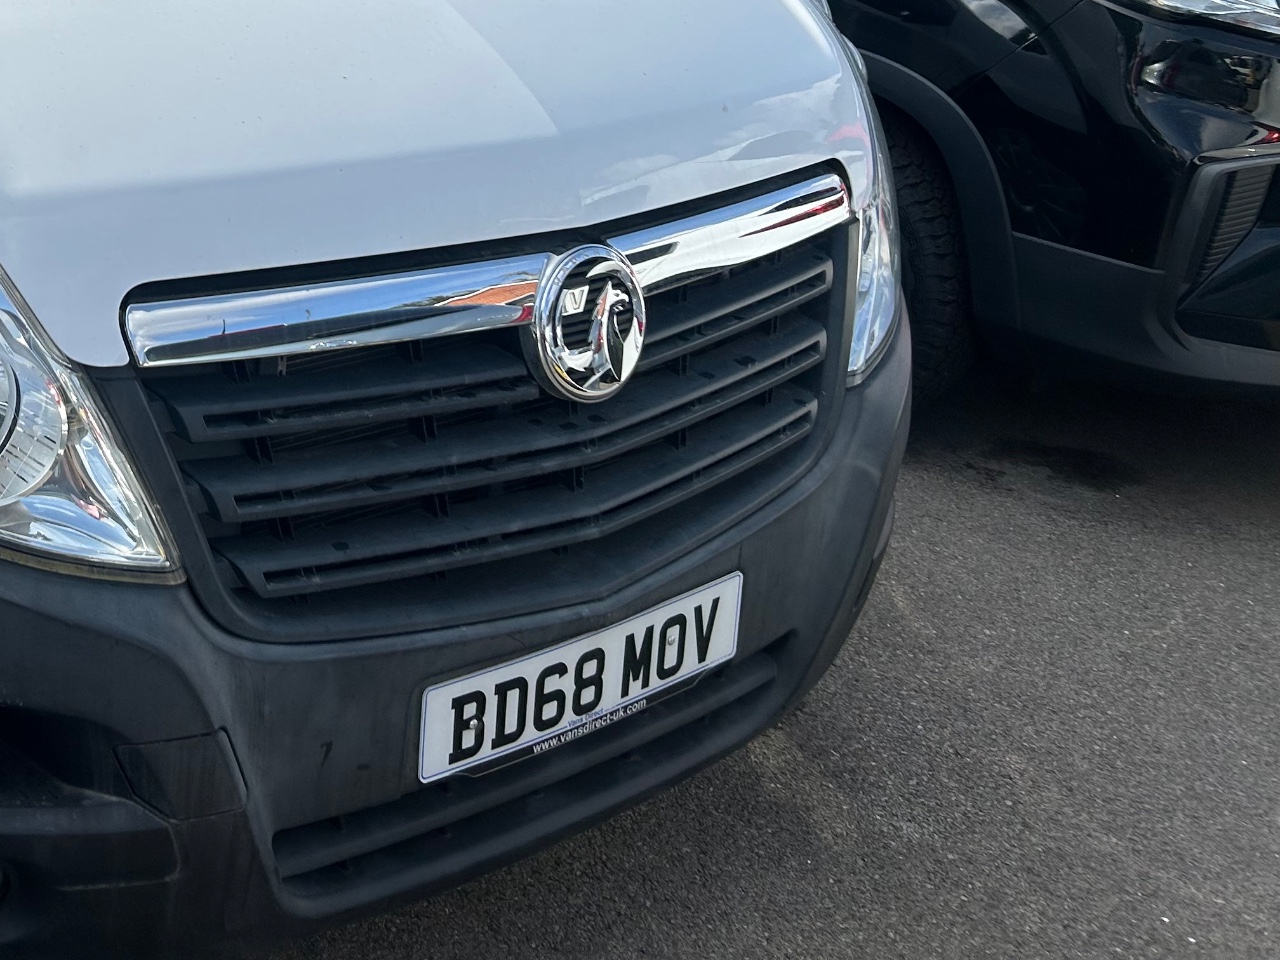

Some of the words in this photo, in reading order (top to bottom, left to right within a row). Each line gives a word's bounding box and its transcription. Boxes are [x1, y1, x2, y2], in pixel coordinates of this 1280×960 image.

[448, 647, 606, 766] BD68
[620, 596, 721, 699] MOV
[532, 698, 647, 754] www.vansdirect-uk.com
